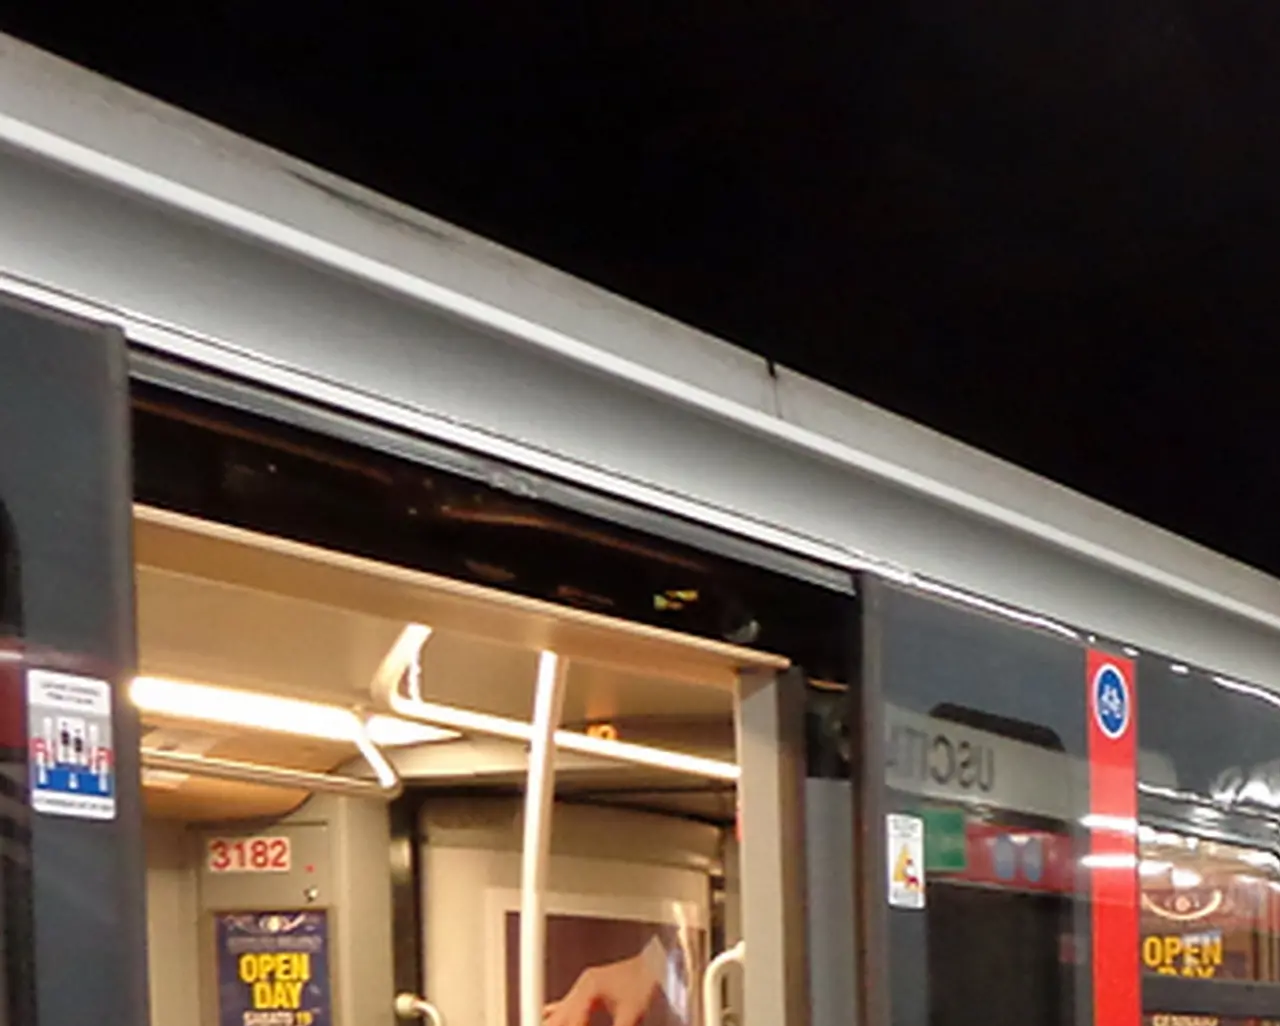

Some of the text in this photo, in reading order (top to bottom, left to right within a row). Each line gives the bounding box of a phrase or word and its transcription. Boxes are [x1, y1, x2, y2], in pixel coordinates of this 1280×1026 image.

[211, 839, 288, 870] 3182
[1143, 934, 1222, 967] OPEN
[240, 952, 309, 983] OPEN
[253, 980, 303, 1009] DAY
